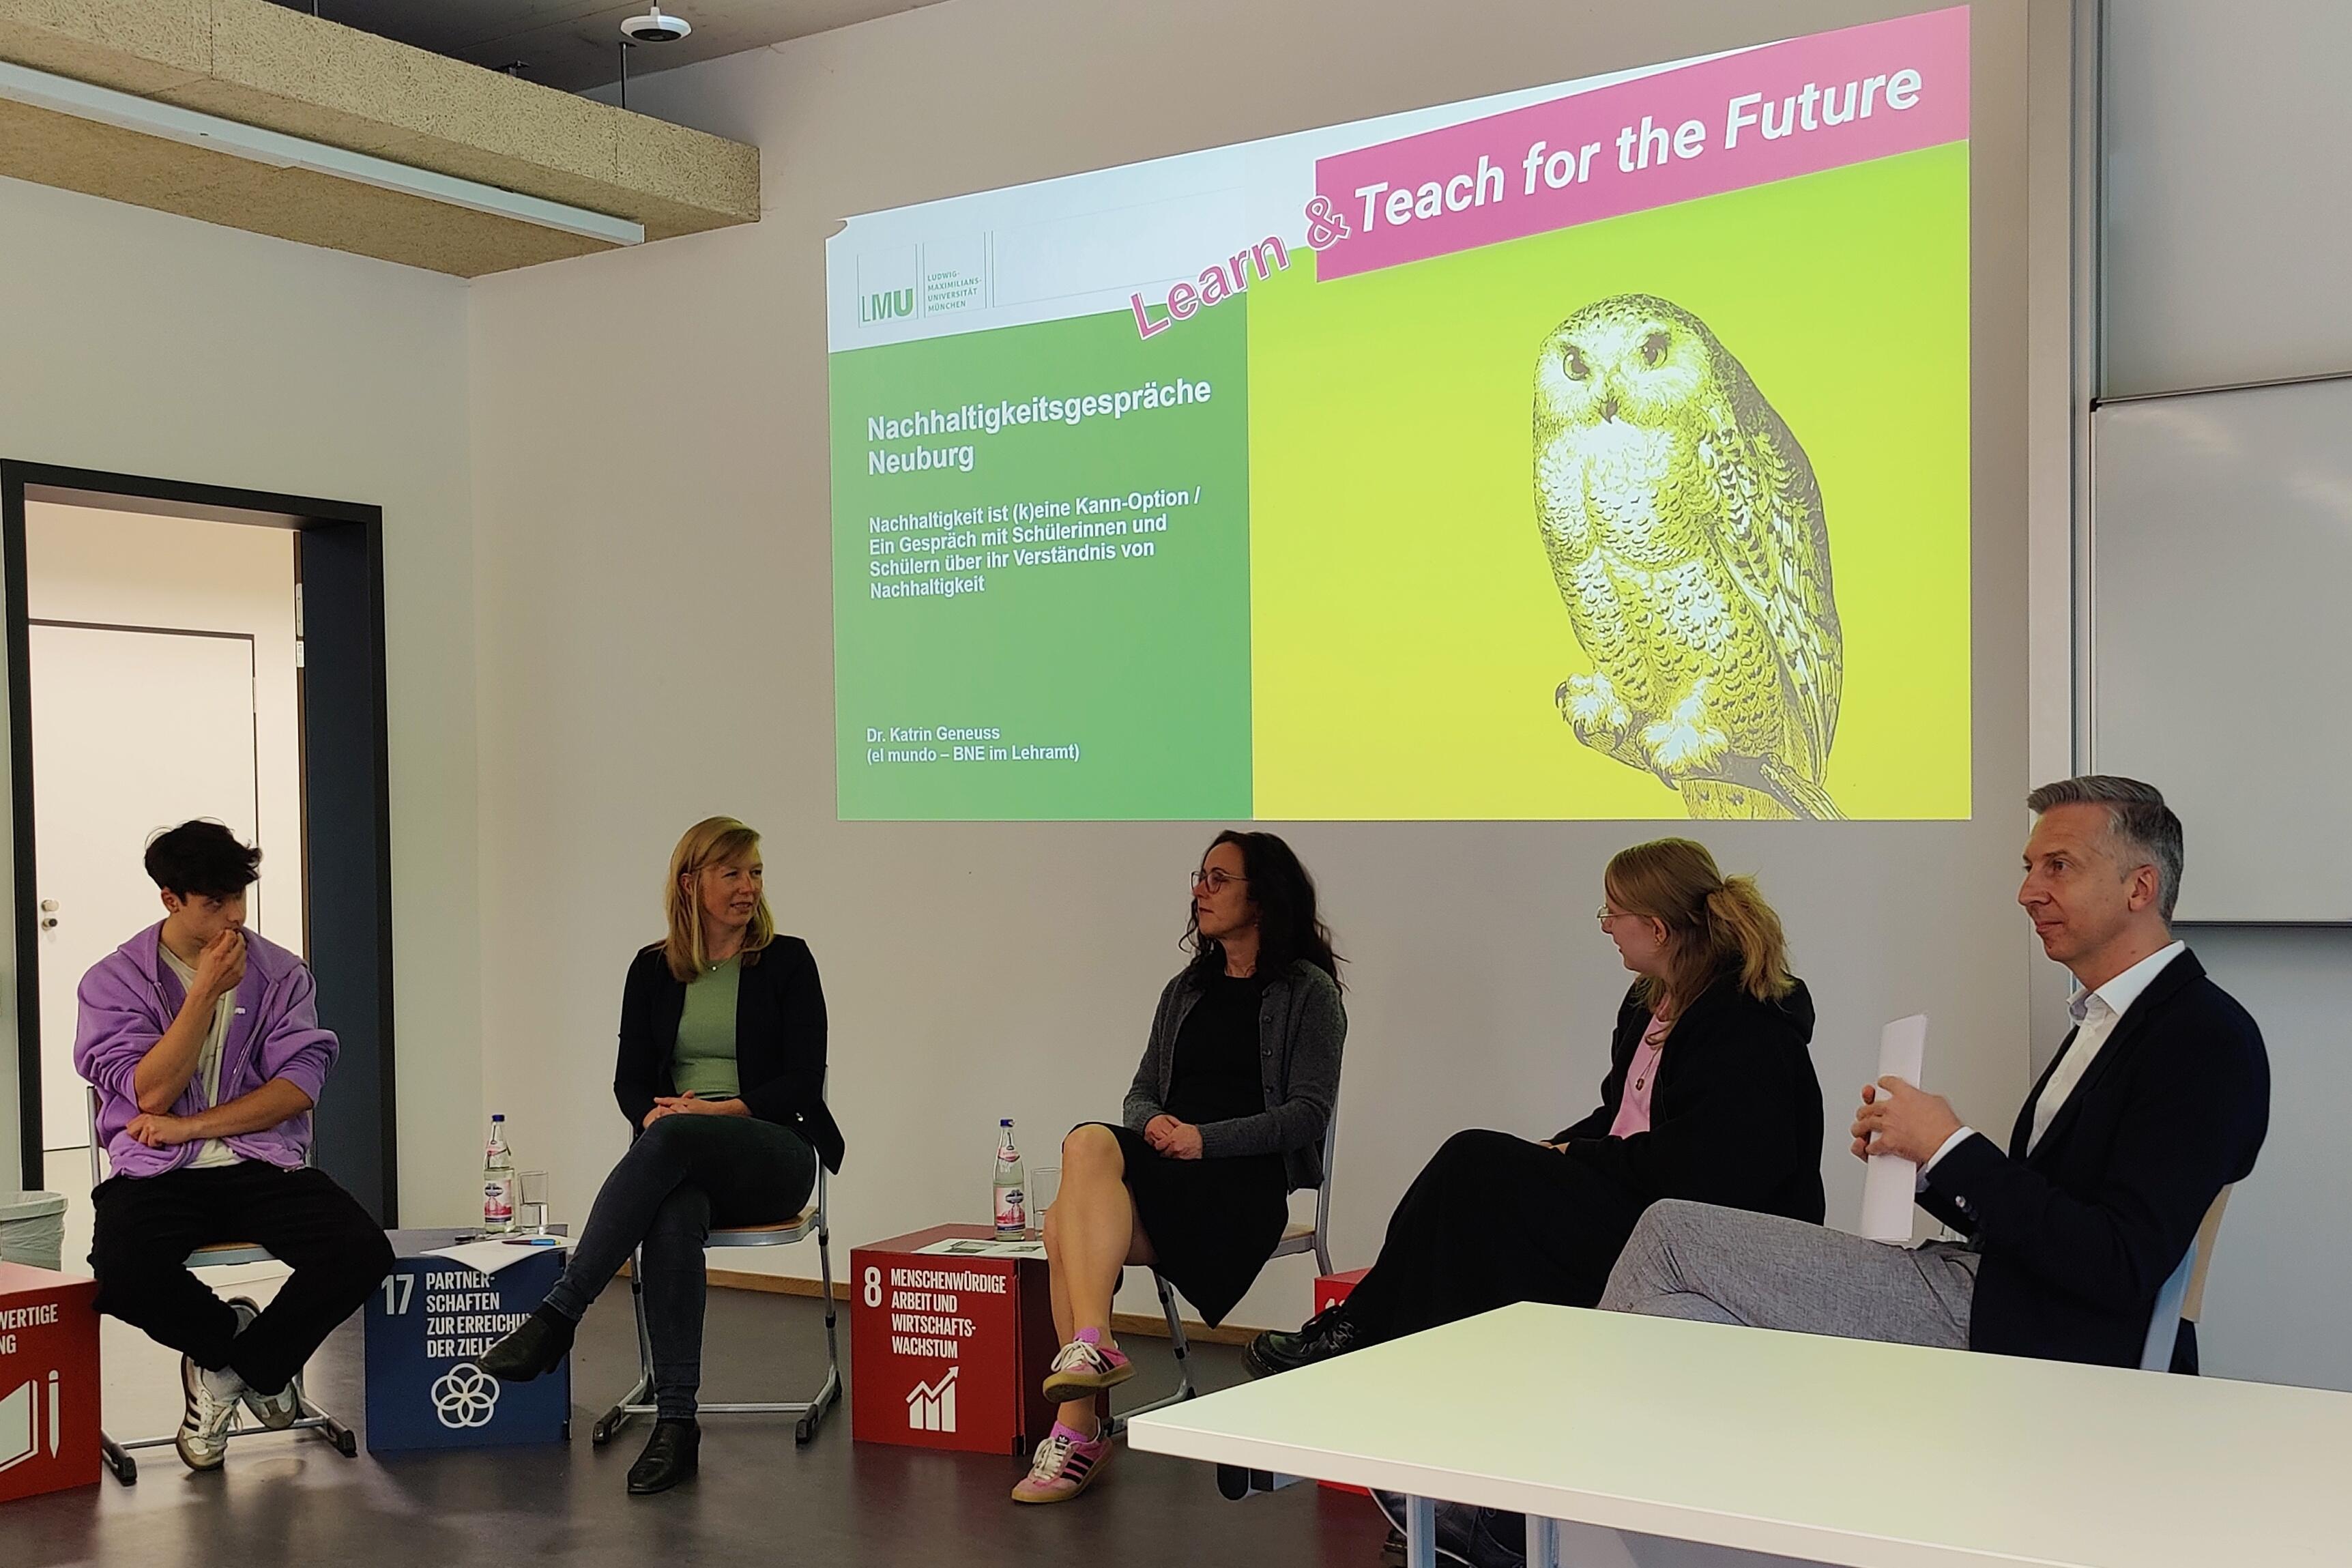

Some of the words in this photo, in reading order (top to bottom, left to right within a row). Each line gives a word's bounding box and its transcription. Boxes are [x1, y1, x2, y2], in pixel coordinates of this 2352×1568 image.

[1130, 235, 1290, 340] Learn
[1304, 195, 1351, 251] &
[1354, 154, 1505, 233] Teach
[1522, 141, 1601, 196] for
[1615, 115, 1707, 173] the
[1724, 68, 1922, 150] Future
[927, 270, 960, 282] LUDWIG-
[927, 277, 982, 291] MAXIMILIANS-
[862, 288, 914, 322] LMU
[928, 287, 977, 302] UNIVERSITÄT
[928, 300, 966, 312] MÜNCHEN
[867, 377, 1211, 442] Nachhaltigkeitsgespräche
[868, 444, 974, 476] Neuburg
[869, 507, 983, 534] Nachhaltigkeit
[987, 505, 1009, 523] ist
[1013, 501, 1070, 524] (k)eine
[1075, 489, 1189, 515] Kann-Option
[1193, 485, 1201, 504] /
[869, 538, 895, 555] Ein
[899, 531, 976, 554] Gespräch
[981, 528, 1008, 546] mit
[1012, 520, 1127, 543] Schülerinnen
[1132, 513, 1167, 534] und
[870, 557, 940, 577] Schülern
[945, 554, 982, 571] über
[987, 551, 1009, 568] ihr
[1013, 542, 1116, 566] Verständnis
[1121, 541, 1155, 557] von
[870, 575, 985, 599] Nachhaltigkeit
[867, 727, 886, 742] Dr.
[890, 727, 932, 742] Katrin
[936, 726, 1000, 740] Geneuss
[867, 749, 884, 765] (el
[888, 747, 936, 762] mundo
[953, 746, 985, 761] BNE
[989, 746, 1007, 760] im
[1012, 743, 1079, 762] Lehramt)
[426, 1271, 495, 1290] PARTNER-
[864, 1266, 882, 1307] 8
[890, 1268, 1006, 1294] MENSCHENWÜRDIGE
[381, 1274, 414, 1315] 17
[426, 1292, 499, 1313] SCHAFTEN
[891, 1291, 931, 1311] ARBEIT
[933, 1294, 957, 1313] UND
[426, 1317, 454, 1335] ZUR
[457, 1313, 532, 1334] ERREICHU
[891, 1313, 976, 1337] WIRTSCHAFTS-
[426, 1339, 454, 1358] DER
[892, 1335, 958, 1359] WACHSTUM
